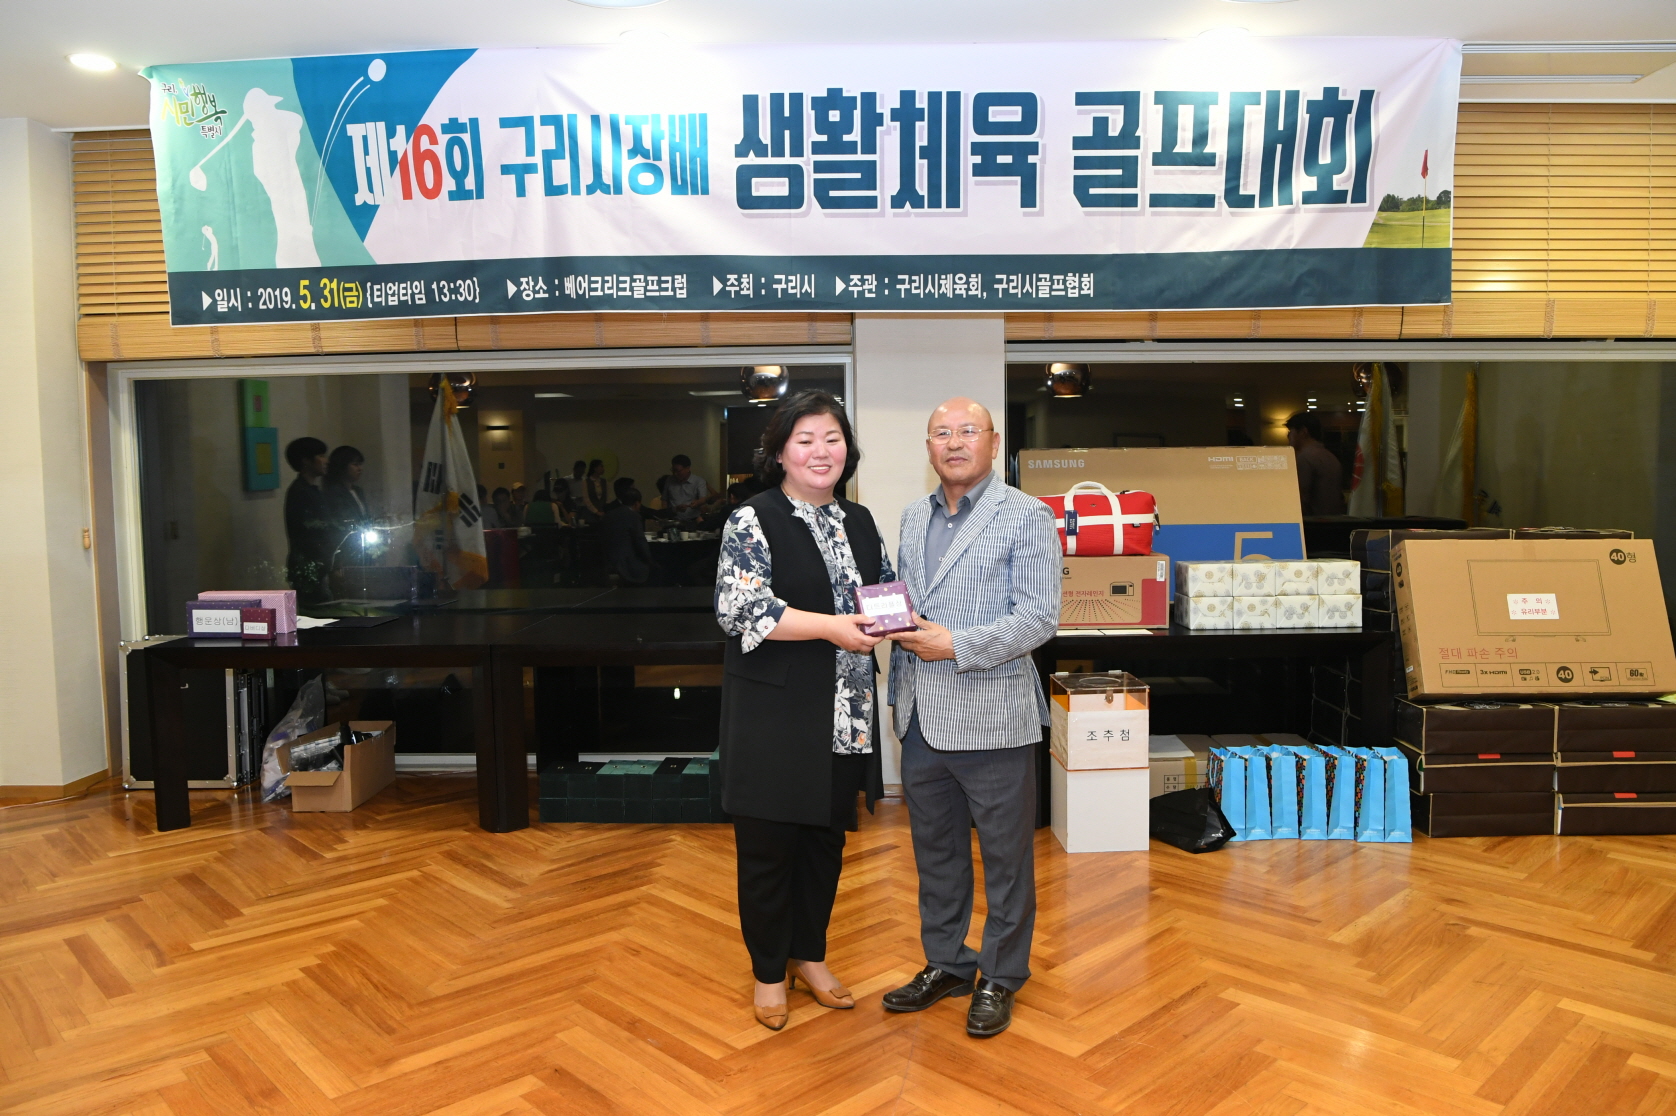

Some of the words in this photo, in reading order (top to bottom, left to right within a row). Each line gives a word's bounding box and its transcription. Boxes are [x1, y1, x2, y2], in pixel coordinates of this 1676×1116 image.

[346, 117, 485, 206] 제16회
[499, 113, 710, 198] 구리시장배
[733, 87, 1043, 213] 생활체육
[1071, 86, 1378, 211] 골프대회
[214, 287, 242, 312] 일시
[257, 287, 296, 310] 2019.
[319, 278, 363, 310] 31(금)
[431, 276, 480, 303] 13:30}
[519, 275, 549, 301] 장소
[564, 273, 687, 299] 베어크리크골프크럽
[725, 273, 753, 298] 주최
[772, 273, 815, 298] 구리시
[848, 273, 877, 298] 주관
[895, 273, 987, 300] 구리시체육회,
[993, 272, 1094, 298] 구리시골프협회
[1027, 458, 1085, 469] SAMSUNG
[1075, 590, 1105, 598] 전자레인지
[1521, 608, 1548, 616] 유리부분
[195, 616, 239, 627] 행운상(남)
[1438, 647, 1463, 660] 절대
[1466, 647, 1491, 660] 파손
[1494, 647, 1518, 660] 주의
